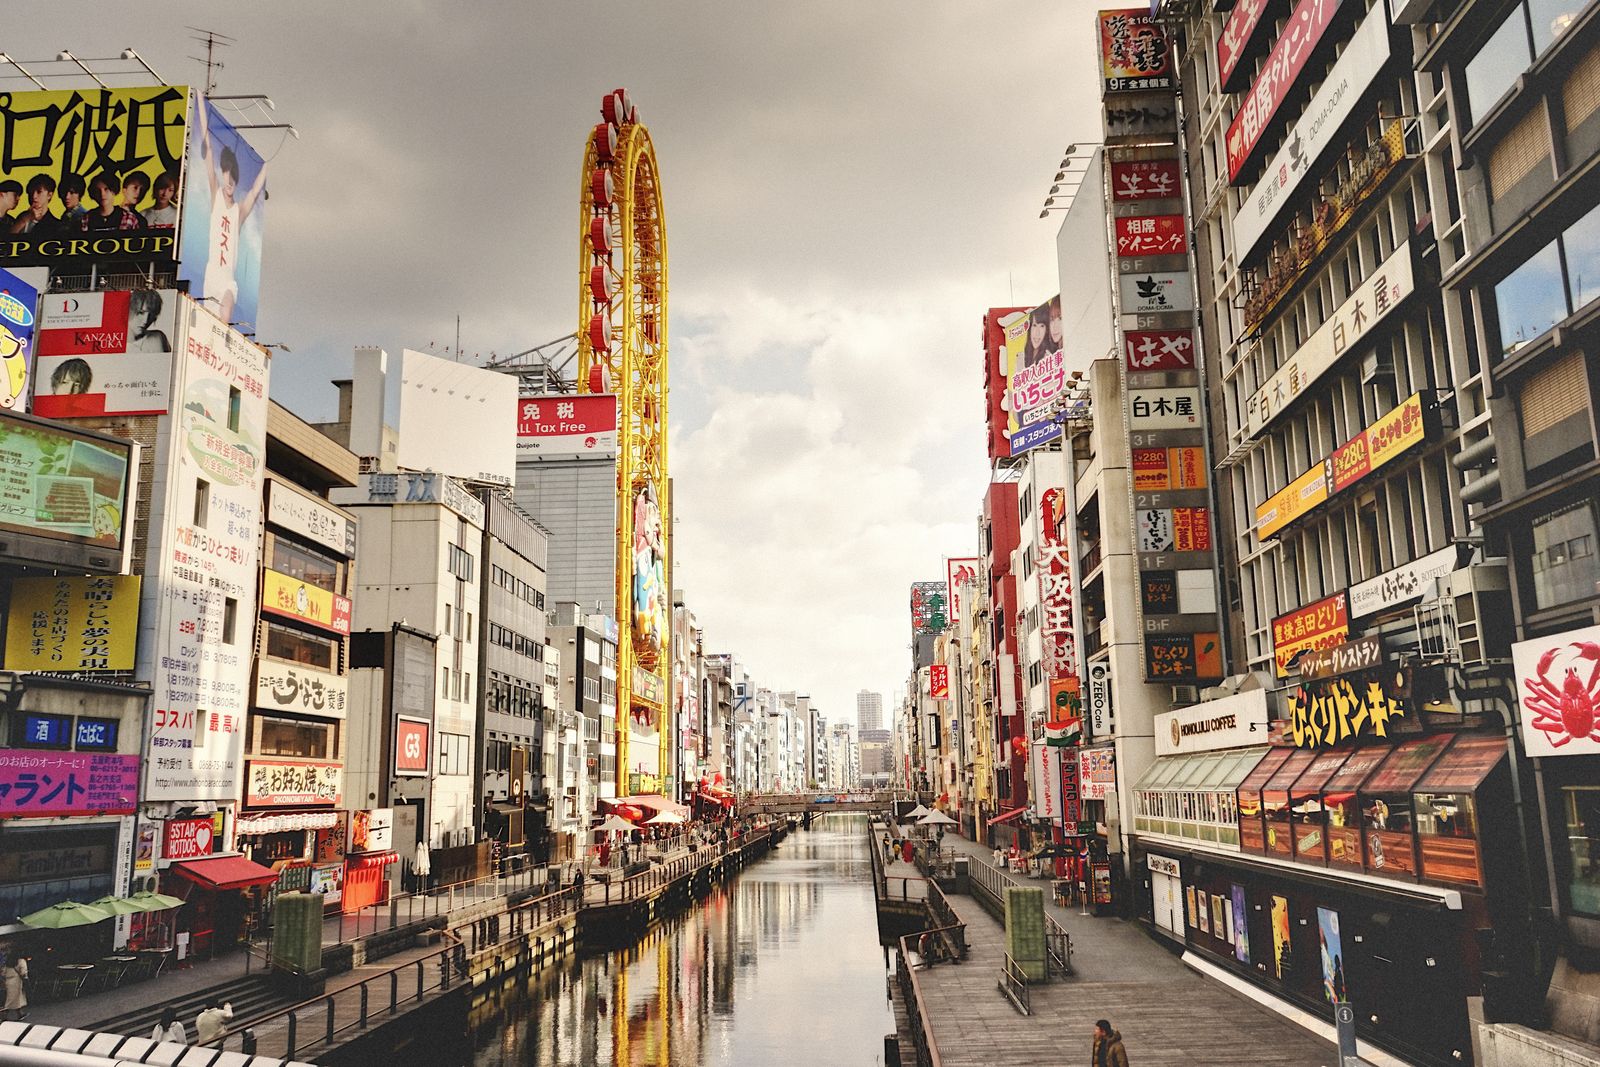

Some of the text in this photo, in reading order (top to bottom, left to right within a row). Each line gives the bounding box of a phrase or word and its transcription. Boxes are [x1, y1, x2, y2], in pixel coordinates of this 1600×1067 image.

[1110, 79, 1169, 90] 9F 全室個室
[1309, 78, 1348, 141] DOMA-DOMA
[0, 88, 186, 178] ロ彼氏
[1126, 219, 1155, 234] 相席
[38, 236, 174, 256] GROUP
[220, 215, 231, 267] ホスト
[1118, 233, 1185, 253] ダイニング
[1120, 259, 1143, 271] 6F
[1138, 316, 1155, 328] 5F
[1332, 274, 1391, 356] 白木屋
[74, 332, 124, 346] KANZAKI
[92, 341, 123, 353] RUKA
[1260, 363, 1301, 423] 白木屋
[522, 402, 575, 420] 免税
[1133, 396, 1195, 417] 白木屋
[535, 422, 556, 433] Tax
[560, 421, 587, 432] Free
[516, 443, 541, 452] Quijote
[1133, 434, 1157, 446] 3F
[1326, 458, 1333, 493] 3F
[1138, 495, 1160, 506] 2F
[1143, 556, 1166, 568] 1F
[31, 610, 48, 656] 応援します
[80, 578, 114, 669] 素晴らしい夢の実現
[1274, 602, 1338, 646] 豊後高田どり
[1300, 640, 1380, 677] ハンバーグレストラン
[938, 666, 946, 687] ツルハ
[1093, 681, 1104, 730] ZERO cafe
[1288, 680, 1405, 749] びっくりドンキー
[155, 709, 194, 729] コスパ
[1181, 714, 1236, 736] HONOLULU COFFEE
[36, 720, 49, 740] 酒
[78, 724, 104, 743] たばこ
[405, 733, 421, 758] G3
[271, 766, 318, 794] お好み焼
[273, 795, 315, 803] OKONOMIYAKI
[170, 823, 195, 838] 5STAR
[169, 839, 196, 854] HOTDOG
